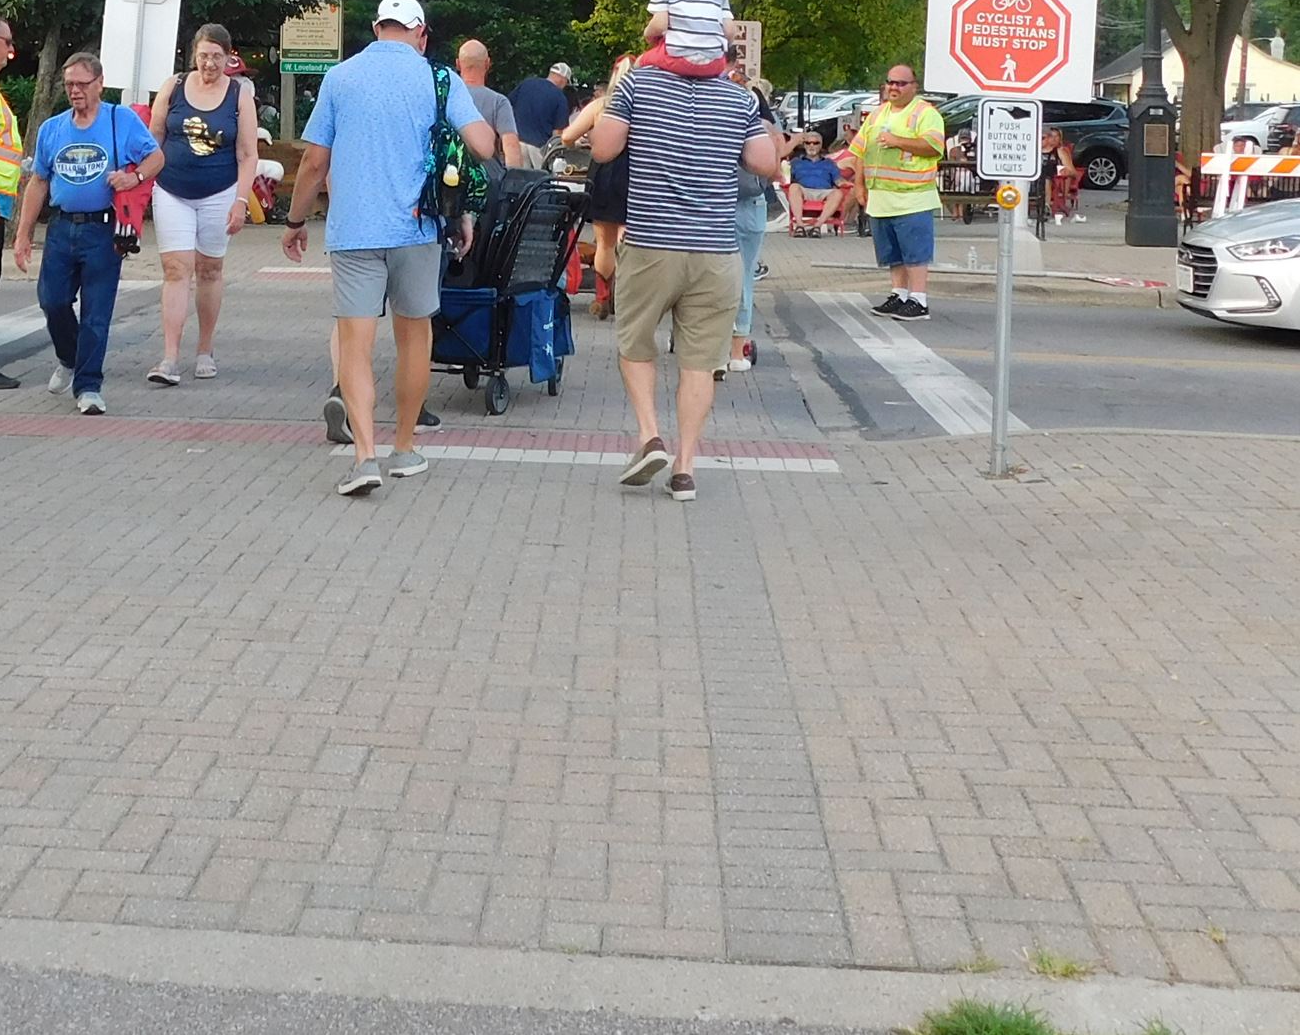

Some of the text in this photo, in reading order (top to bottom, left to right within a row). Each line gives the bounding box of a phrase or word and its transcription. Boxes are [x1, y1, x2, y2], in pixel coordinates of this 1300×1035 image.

[976, 12, 1045, 27] CYCLIST &
[964, 23, 1056, 39] PEDESTRIANS
[971, 35, 1047, 51] MUST STOP
[294, 63, 323, 71] Loveland
[999, 122, 1020, 131] PUSH
[987, 132, 1032, 141] BUTTON TO
[992, 142, 1027, 151] TURN ON
[992, 153, 1027, 162] WARNING
